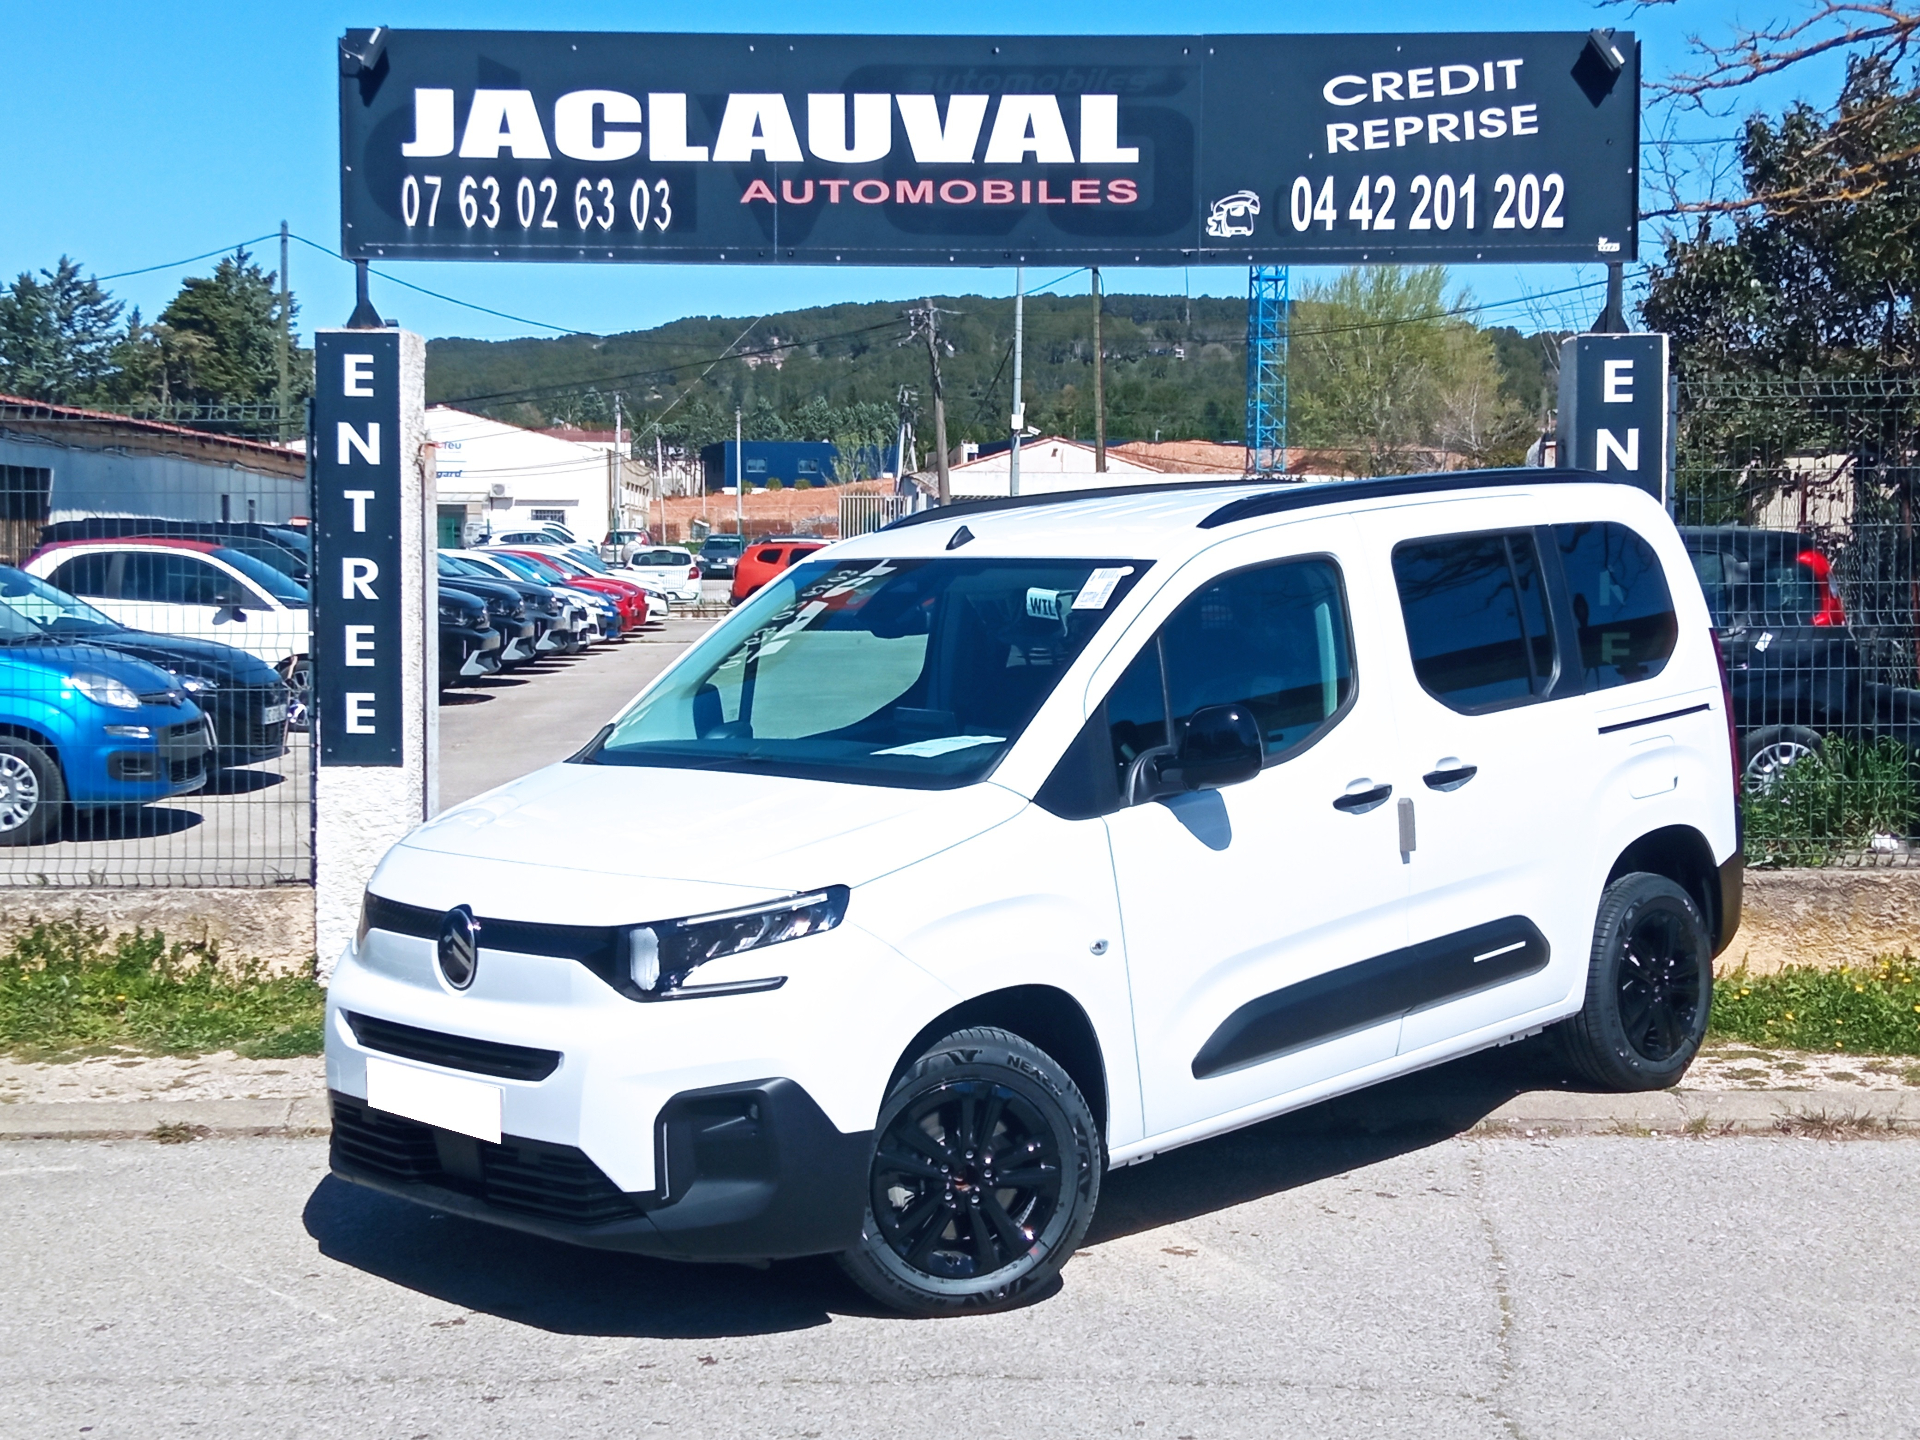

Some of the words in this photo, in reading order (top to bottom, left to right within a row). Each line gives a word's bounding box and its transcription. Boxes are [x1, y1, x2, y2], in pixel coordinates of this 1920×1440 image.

[1322, 58, 1524, 107] CREDIT
[402, 88, 1139, 164] JACLAUVAL
[1326, 102, 1539, 154] REPRISE
[401, 176, 442, 227] 07
[458, 176, 501, 228] 63
[516, 177, 558, 230] 02
[574, 178, 615, 231] 63
[629, 179, 672, 231] 03
[740, 179, 1138, 205] AUTOMOBILES
[1290, 175, 1337, 231] 04
[1348, 174, 1396, 231] 42
[1408, 173, 1476, 231] 201
[1492, 173, 1565, 230] 202
[336, 353, 381, 734] ENTREE
